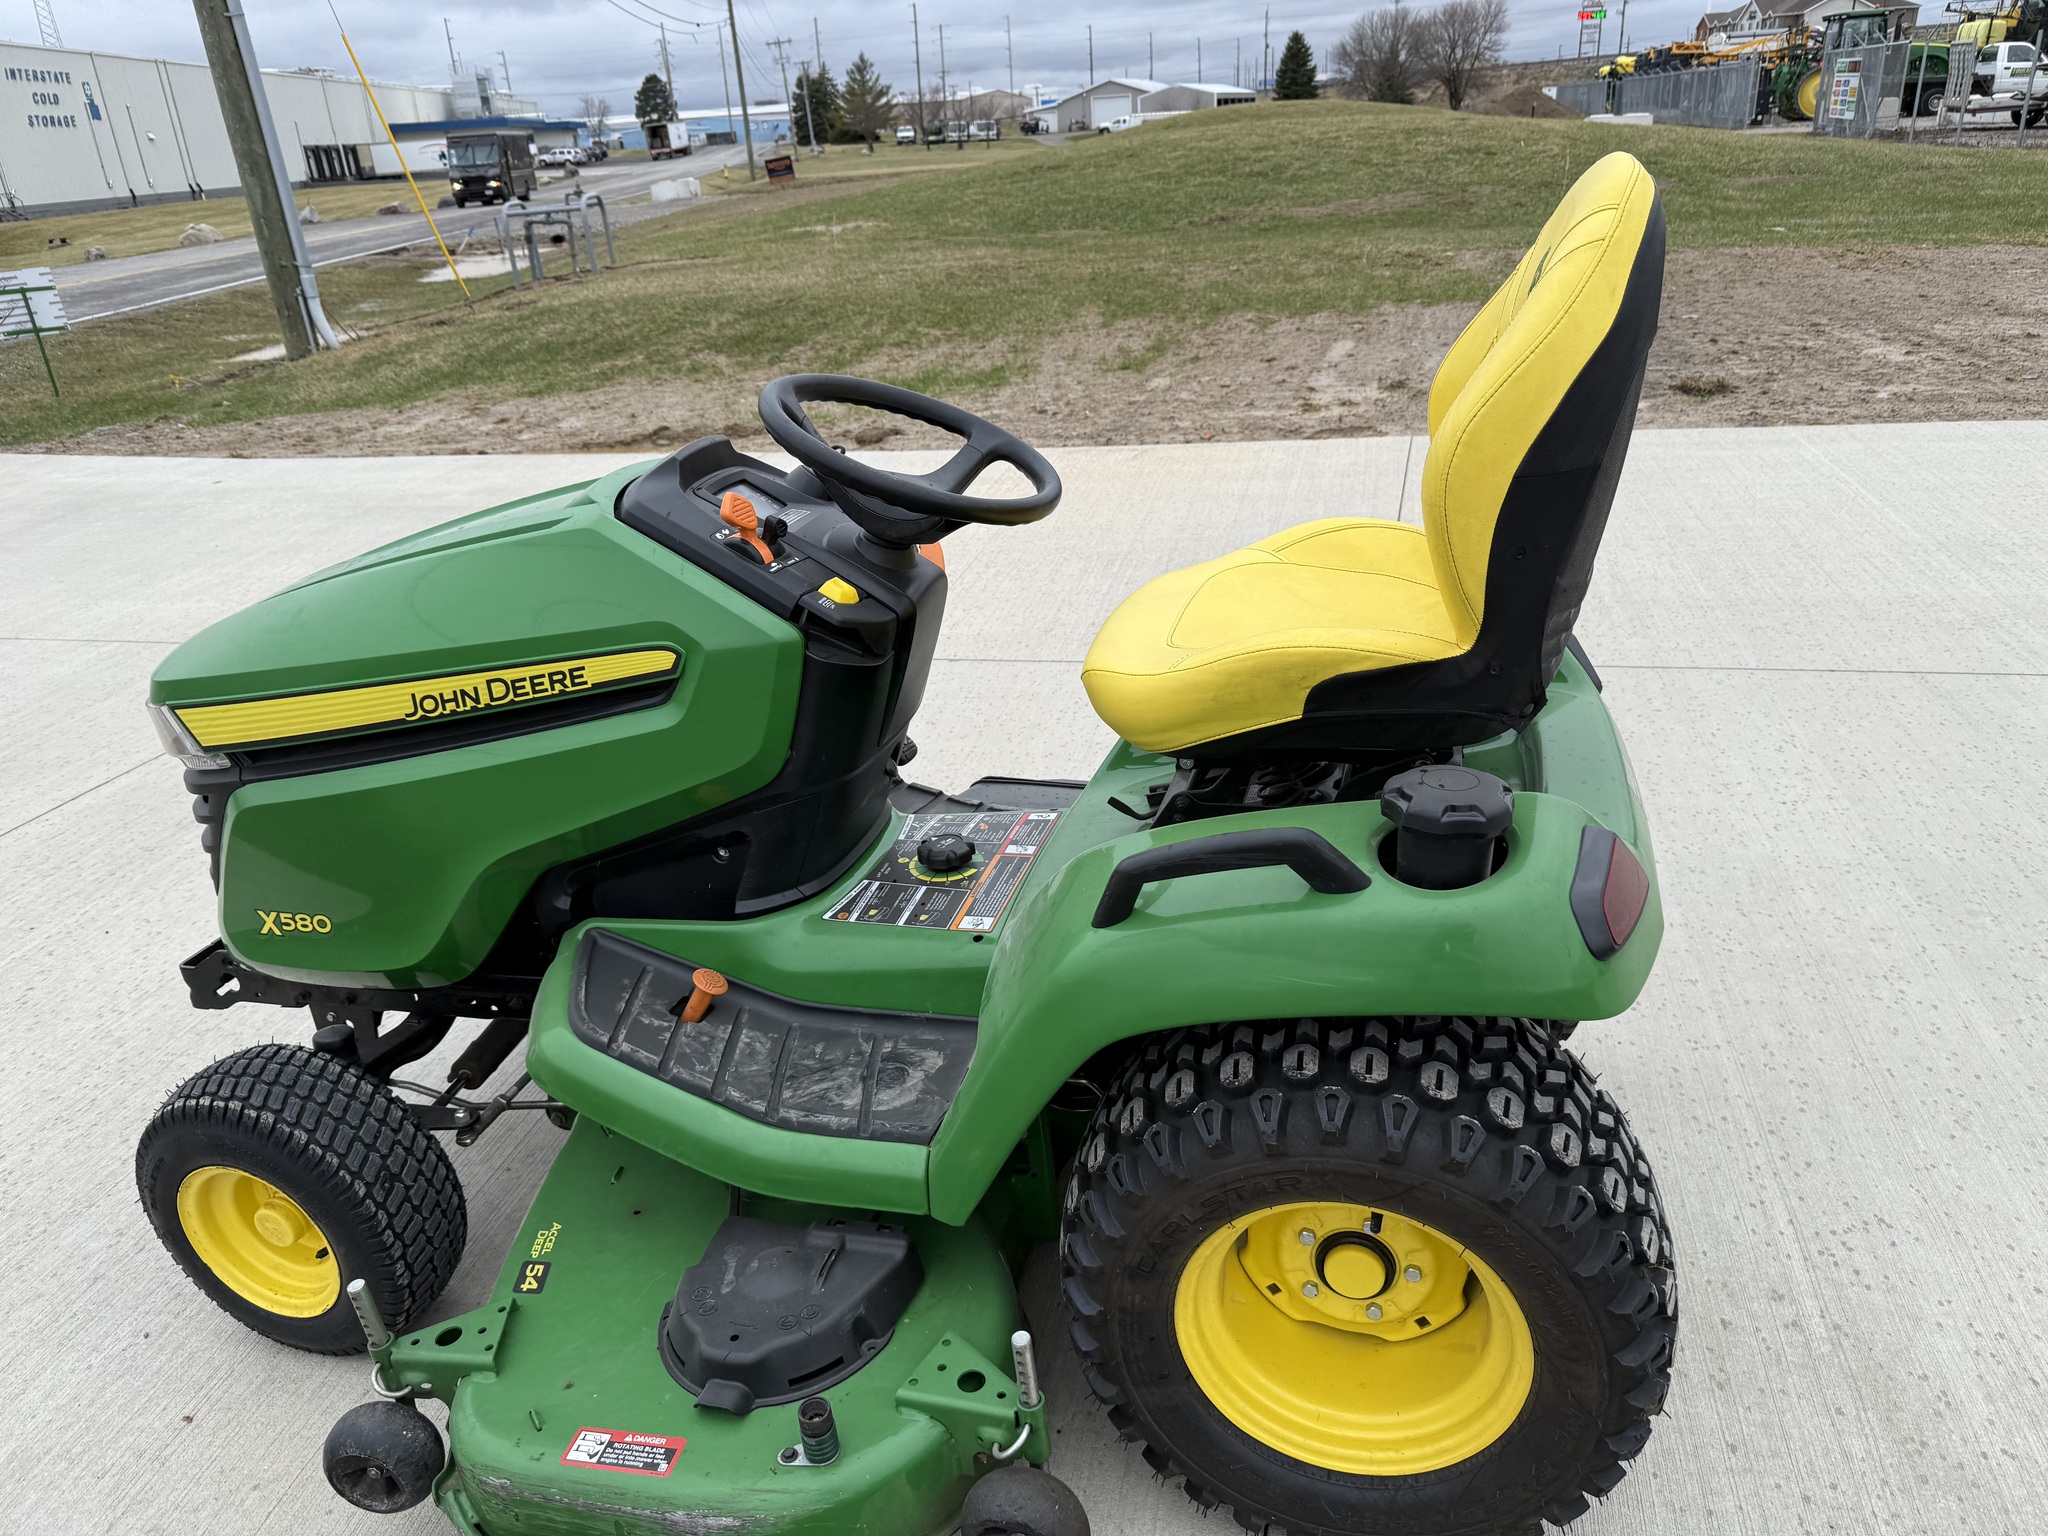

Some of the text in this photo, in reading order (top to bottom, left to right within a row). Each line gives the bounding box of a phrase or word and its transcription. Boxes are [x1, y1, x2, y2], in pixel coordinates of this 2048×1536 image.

[4, 67, 72, 85] INTERSTATE
[32, 92, 60, 105] COLD
[27, 115, 77, 128] STORAGE
[404, 666, 589, 718] JOHN DEERE
[255, 909, 332, 936] X580
[1136, 1176, 1302, 1275] CARLSTAR
[530, 1230, 549, 1259] DEEP
[541, 1222, 562, 1255] ACCEL
[520, 1264, 545, 1292] 54
[633, 1435, 667, 1445] DANGER
[644, 1446, 666, 1454] BLADE
[623, 1459, 644, 1468] running
